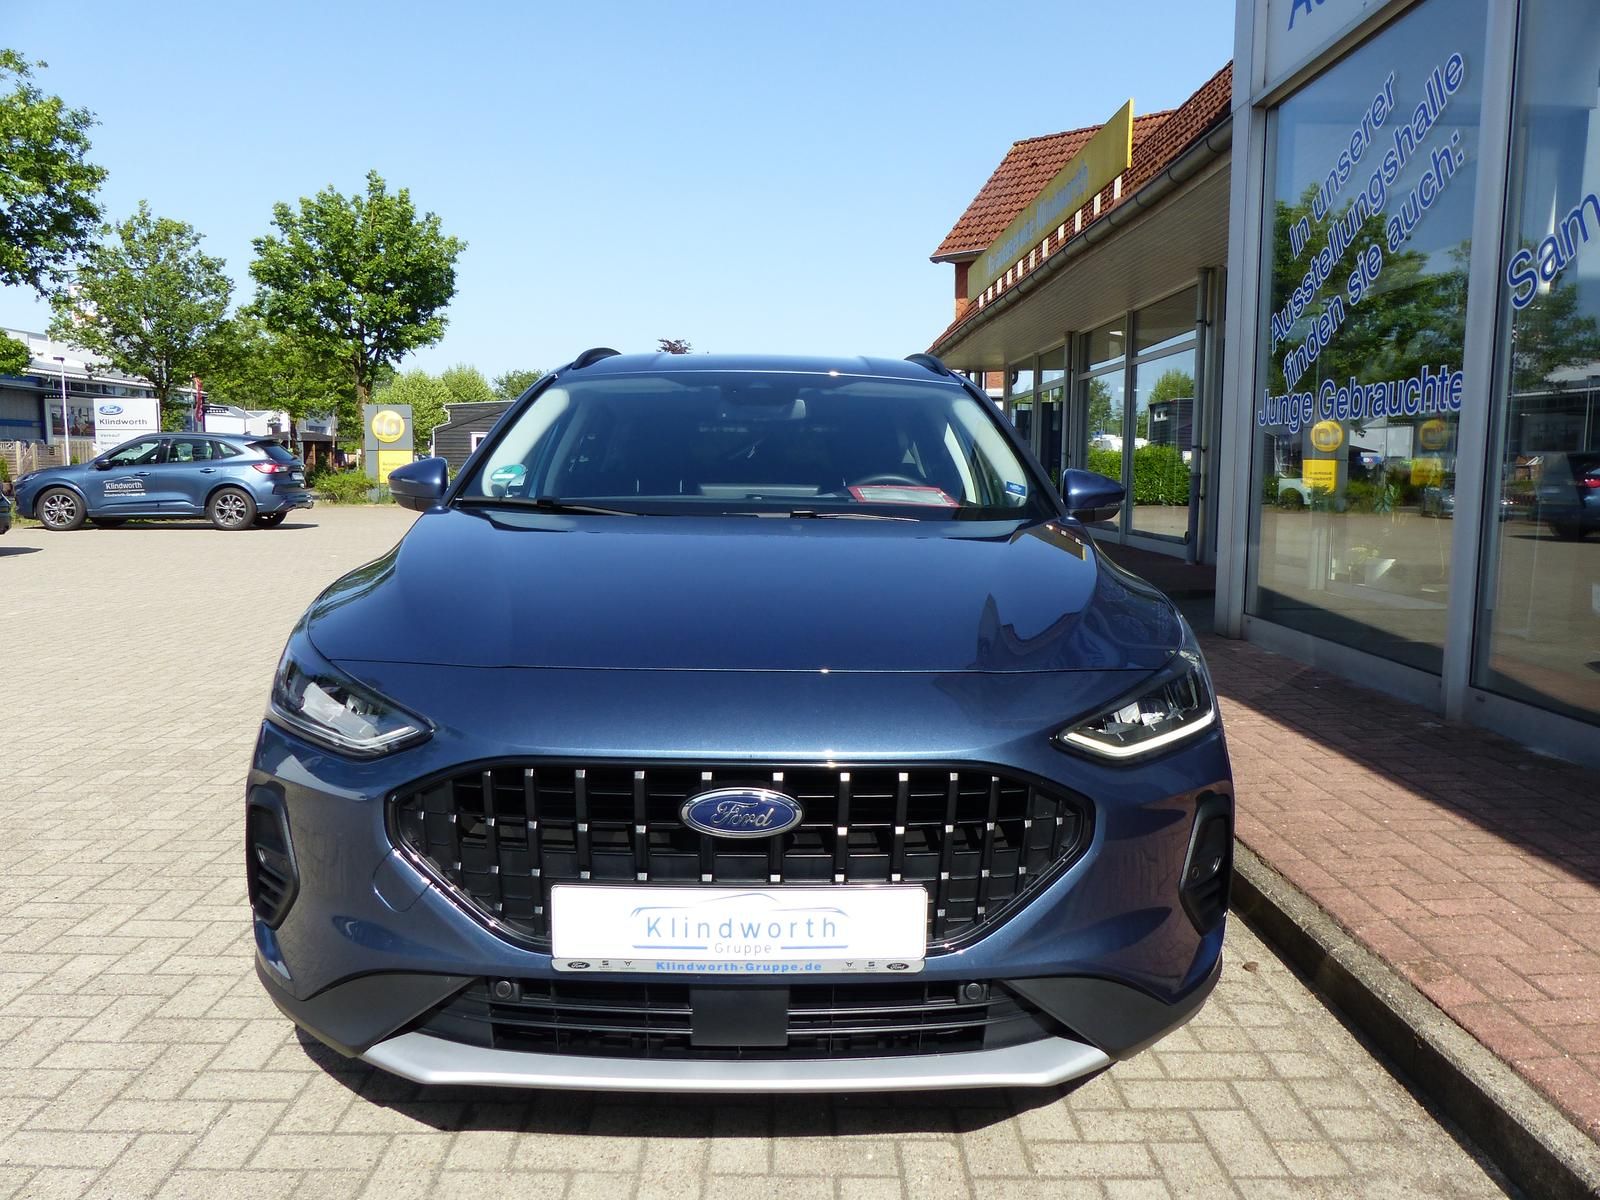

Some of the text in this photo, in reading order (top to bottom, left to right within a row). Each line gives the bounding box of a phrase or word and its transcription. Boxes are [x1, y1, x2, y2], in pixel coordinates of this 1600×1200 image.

[1289, 70, 1395, 259] In unserer
[1271, 52, 1464, 354] Ausstellungshalle
[1283, 129, 1465, 392] finden sie auch:
[1258, 365, 1464, 434] Junge Gebrauchte
[711, 800, 775, 827] Ford
[647, 917, 836, 938] Klindworth
[714, 942, 772, 956] Gruppe
[656, 961, 822, 973] Klindworth-Gruppe.de
